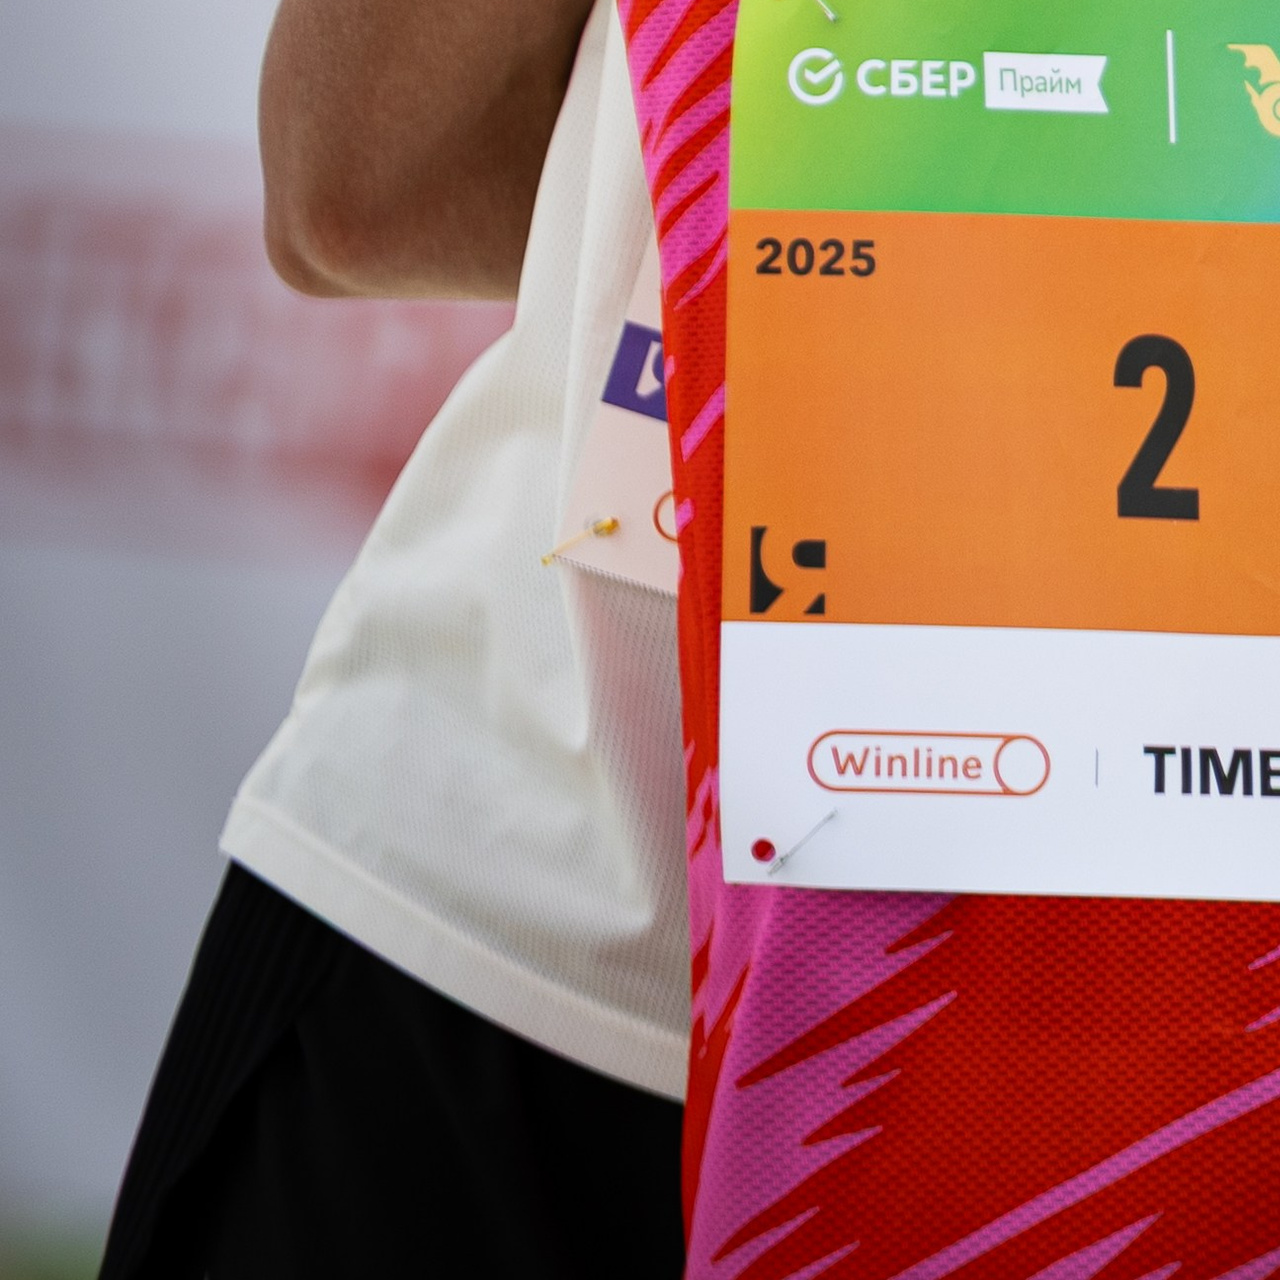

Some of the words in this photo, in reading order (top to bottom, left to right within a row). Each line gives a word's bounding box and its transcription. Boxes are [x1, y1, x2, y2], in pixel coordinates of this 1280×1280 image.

[856, 58, 976, 98] СБЕР
[999, 67, 1082, 97] Прайм
[756, 237, 876, 276] 2025
[1113, 333, 1200, 521] 2
[830, 745, 983, 781] Winline
